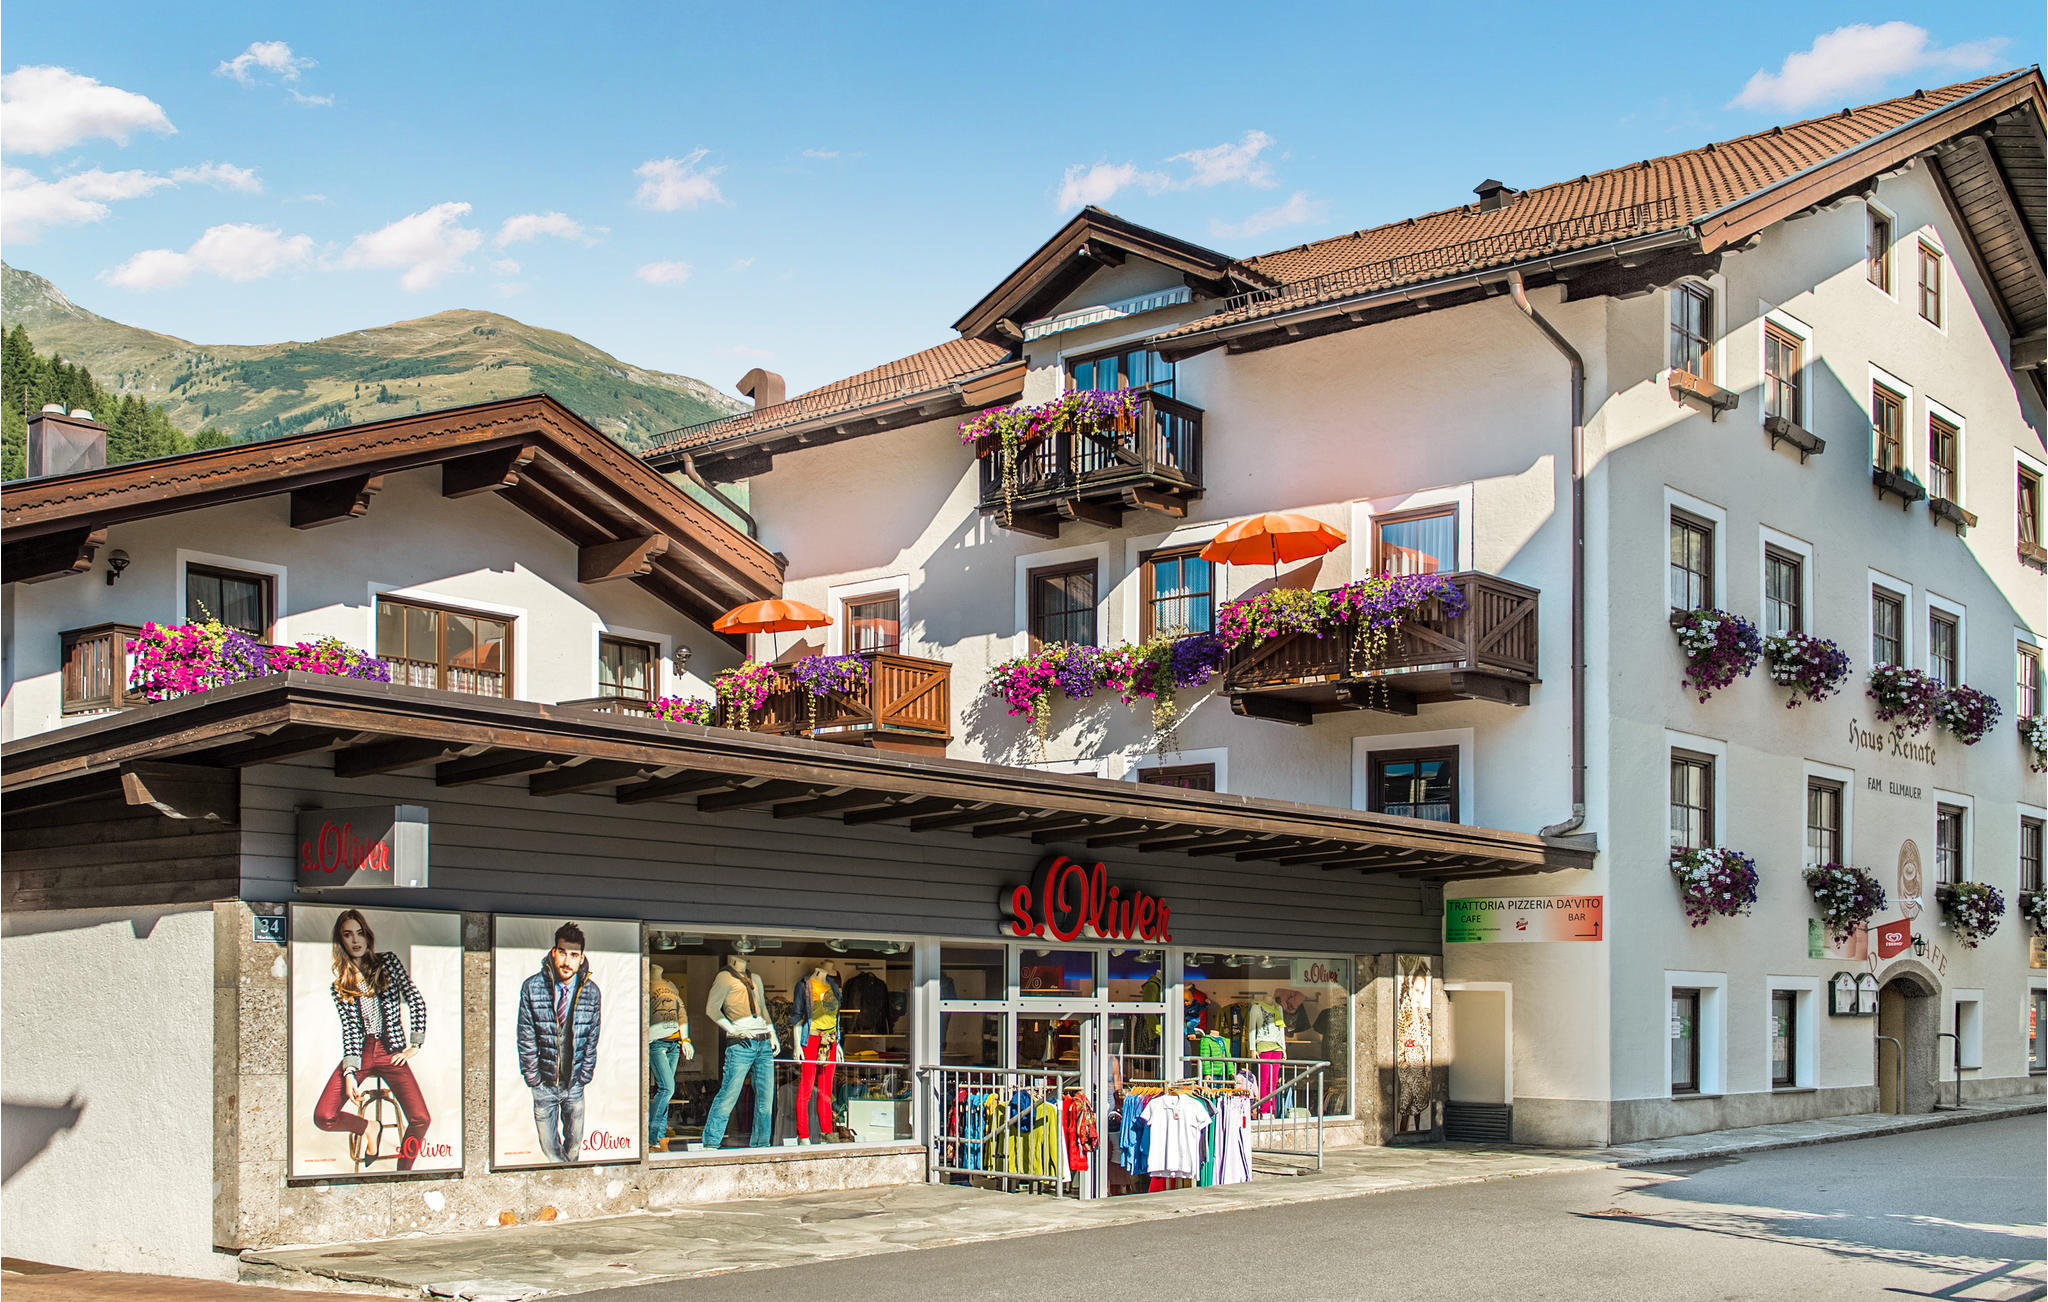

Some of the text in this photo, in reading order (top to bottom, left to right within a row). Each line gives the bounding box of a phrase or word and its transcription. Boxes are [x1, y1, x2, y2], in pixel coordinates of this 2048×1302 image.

[1849, 718, 1937, 766] Haus Renate
[1889, 781, 1922, 800] ELLMAUER
[302, 821, 391, 873] s.Oliver
[1012, 855, 1172, 943] s.Oliver
[1448, 900, 1505, 911] TRATTORIA
[1508, 899, 1554, 910] PIZZERIA
[260, 919, 279, 933] 34
[1460, 913, 1586, 923] CAFE BAR
[1304, 962, 1339, 984] s.Oliver
[395, 1136, 453, 1159] s.Oliver
[582, 1129, 631, 1151] s.Oliver
